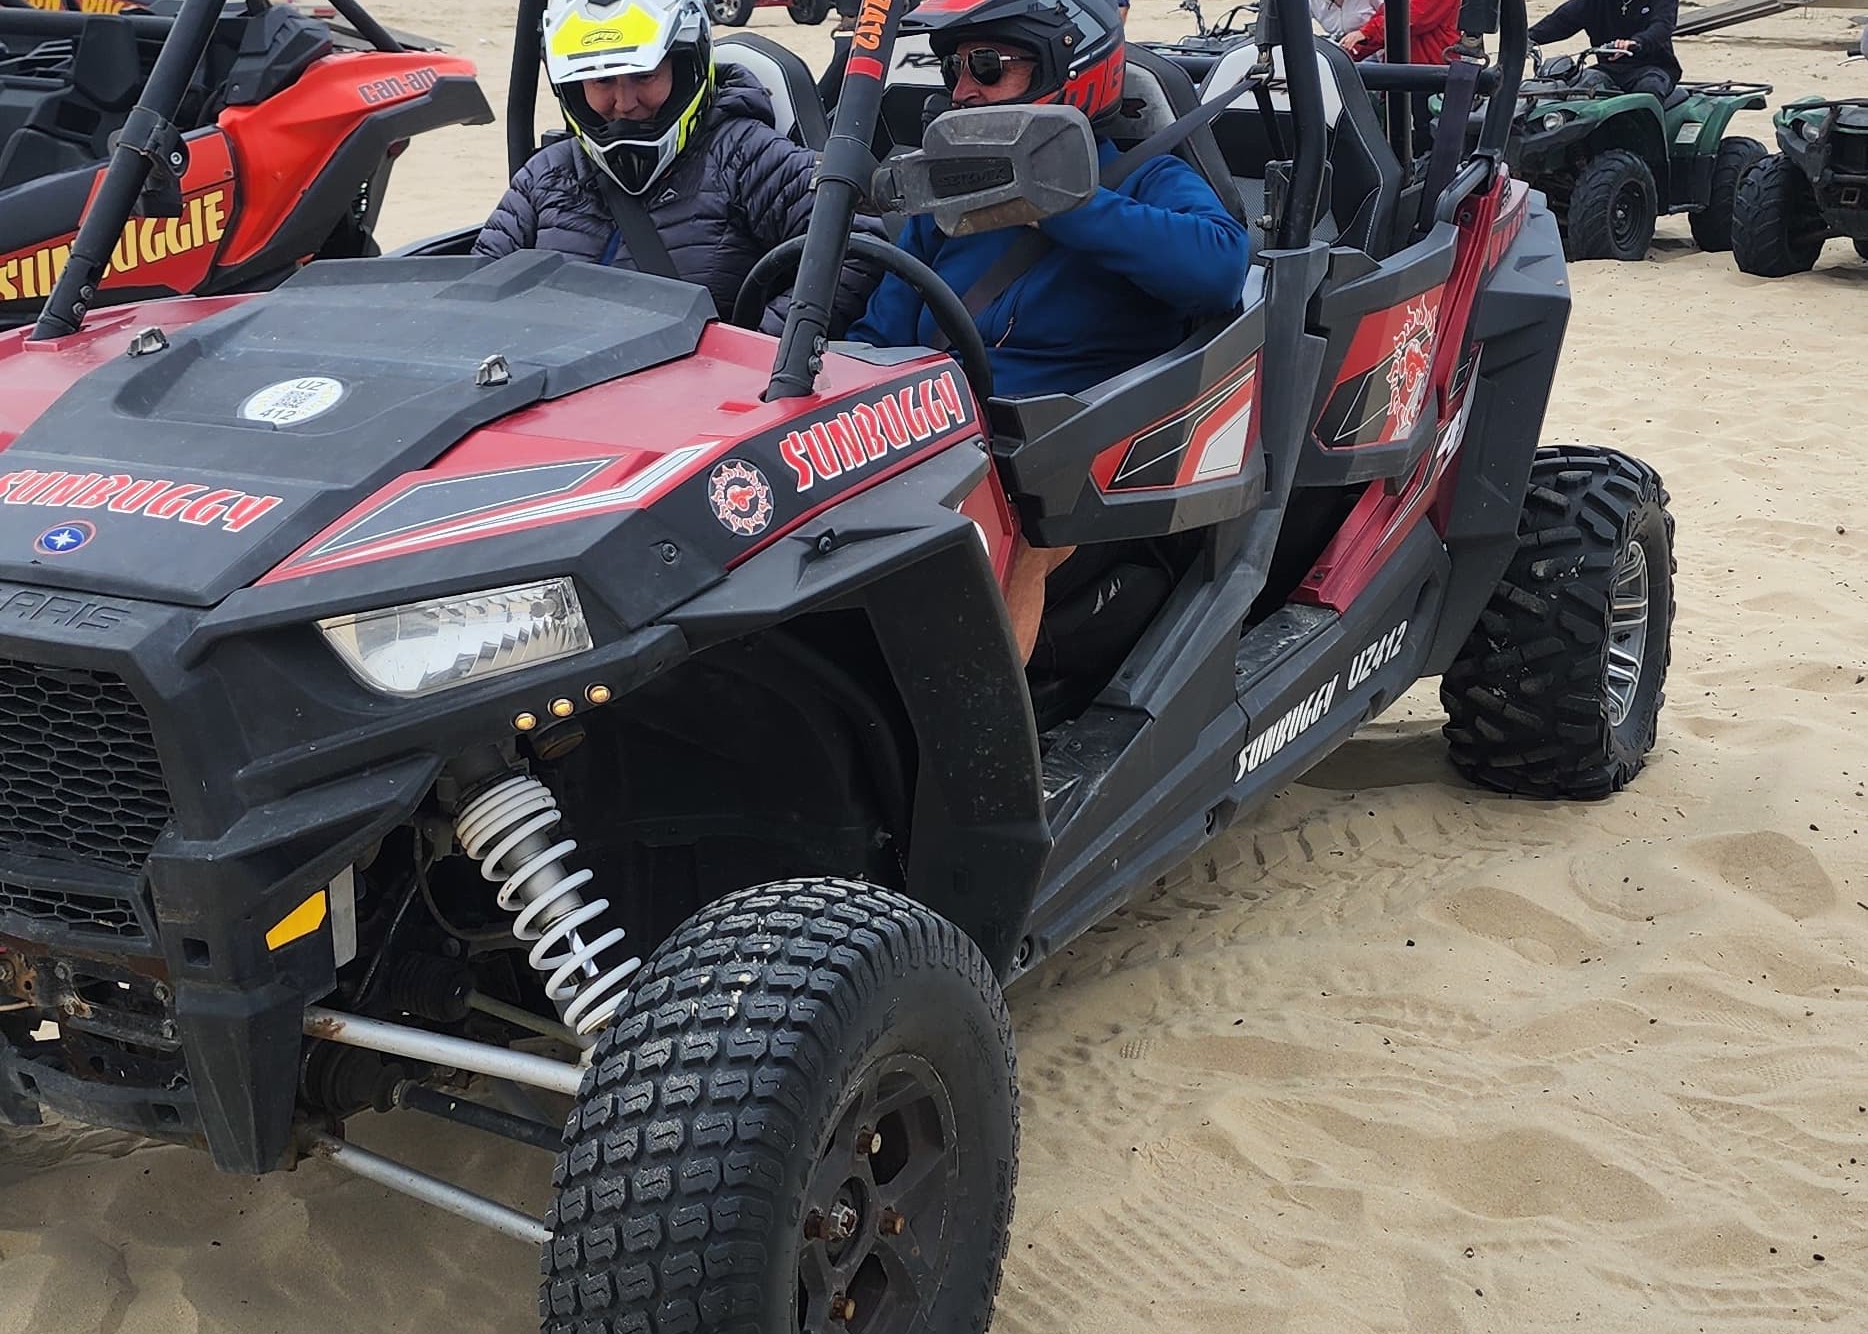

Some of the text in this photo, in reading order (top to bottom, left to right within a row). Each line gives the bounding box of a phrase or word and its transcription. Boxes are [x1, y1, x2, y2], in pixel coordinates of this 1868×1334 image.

[0, 190, 225, 300] SUUGGIE
[258, 408, 297, 421] 412
[296, 379, 328, 391] UZ
[778, 371, 967, 493] SUNBUGGY
[0, 588, 131, 630] ARIS
[1234, 620, 1408, 784] SUNBUGGY UZ412
